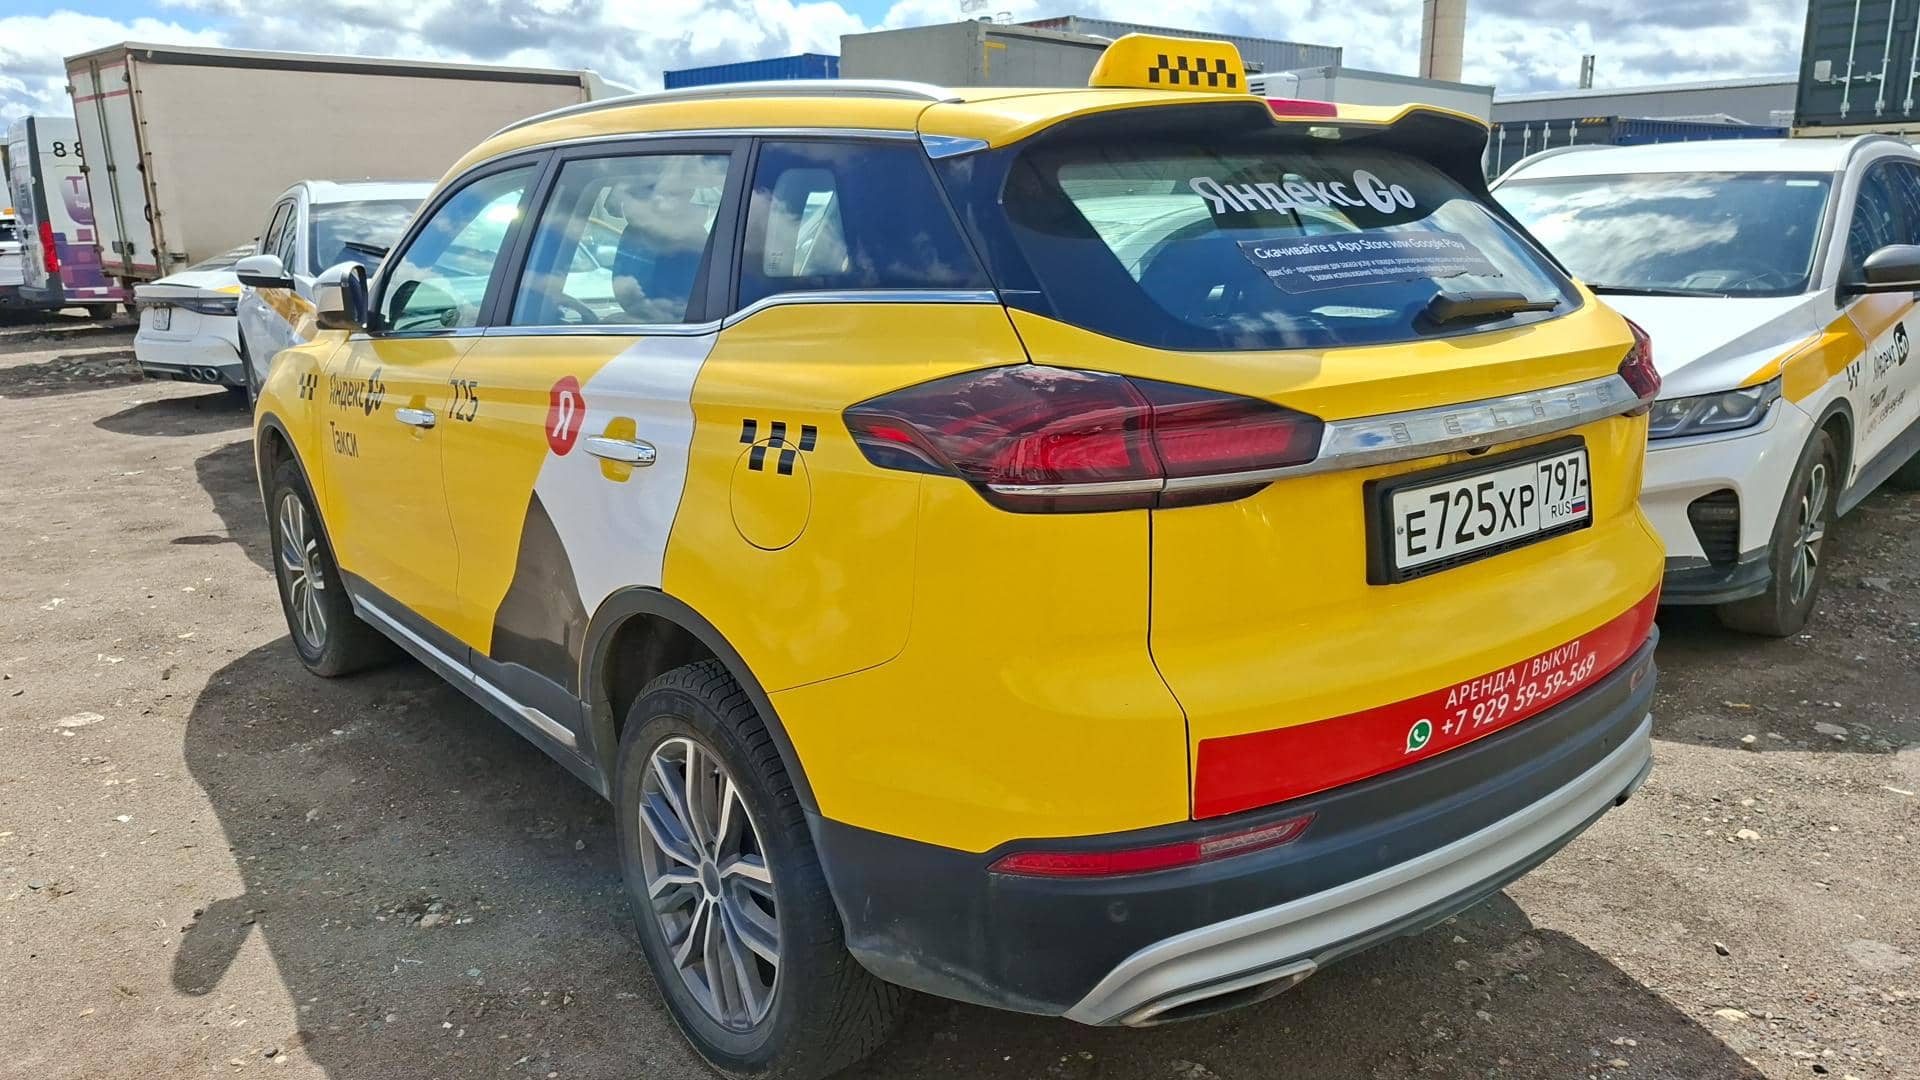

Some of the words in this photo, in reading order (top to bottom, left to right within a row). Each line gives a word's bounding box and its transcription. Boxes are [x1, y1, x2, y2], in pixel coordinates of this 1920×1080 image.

[1189, 176, 1364, 215] Яндекс
[1353, 169, 1416, 214] Go
[1254, 243, 1329, 259] Скачивайте
[1328, 243, 1338, 252] в
[1336, 240, 1362, 253] App
[1361, 239, 1392, 250] Store
[1391, 240, 1411, 249] или
[1409, 238, 1443, 250] Google
[329, 373, 366, 413] Яндекс
[448, 379, 478, 422] 725
[552, 390, 576, 441] Я
[1388, 383, 1613, 445] BELGEE
[329, 421, 359, 458] Такси
[1540, 457, 1581, 506] 797
[1551, 504, 1571, 518] RUS
[1441, 709, 1469, 735] +7
[1473, 693, 1509, 728] 929
[1514, 651, 1597, 712] 59-59-569
[1445, 674, 1516, 709] АРЕНДА
[1532, 640, 1580, 677] ВЫКУП
